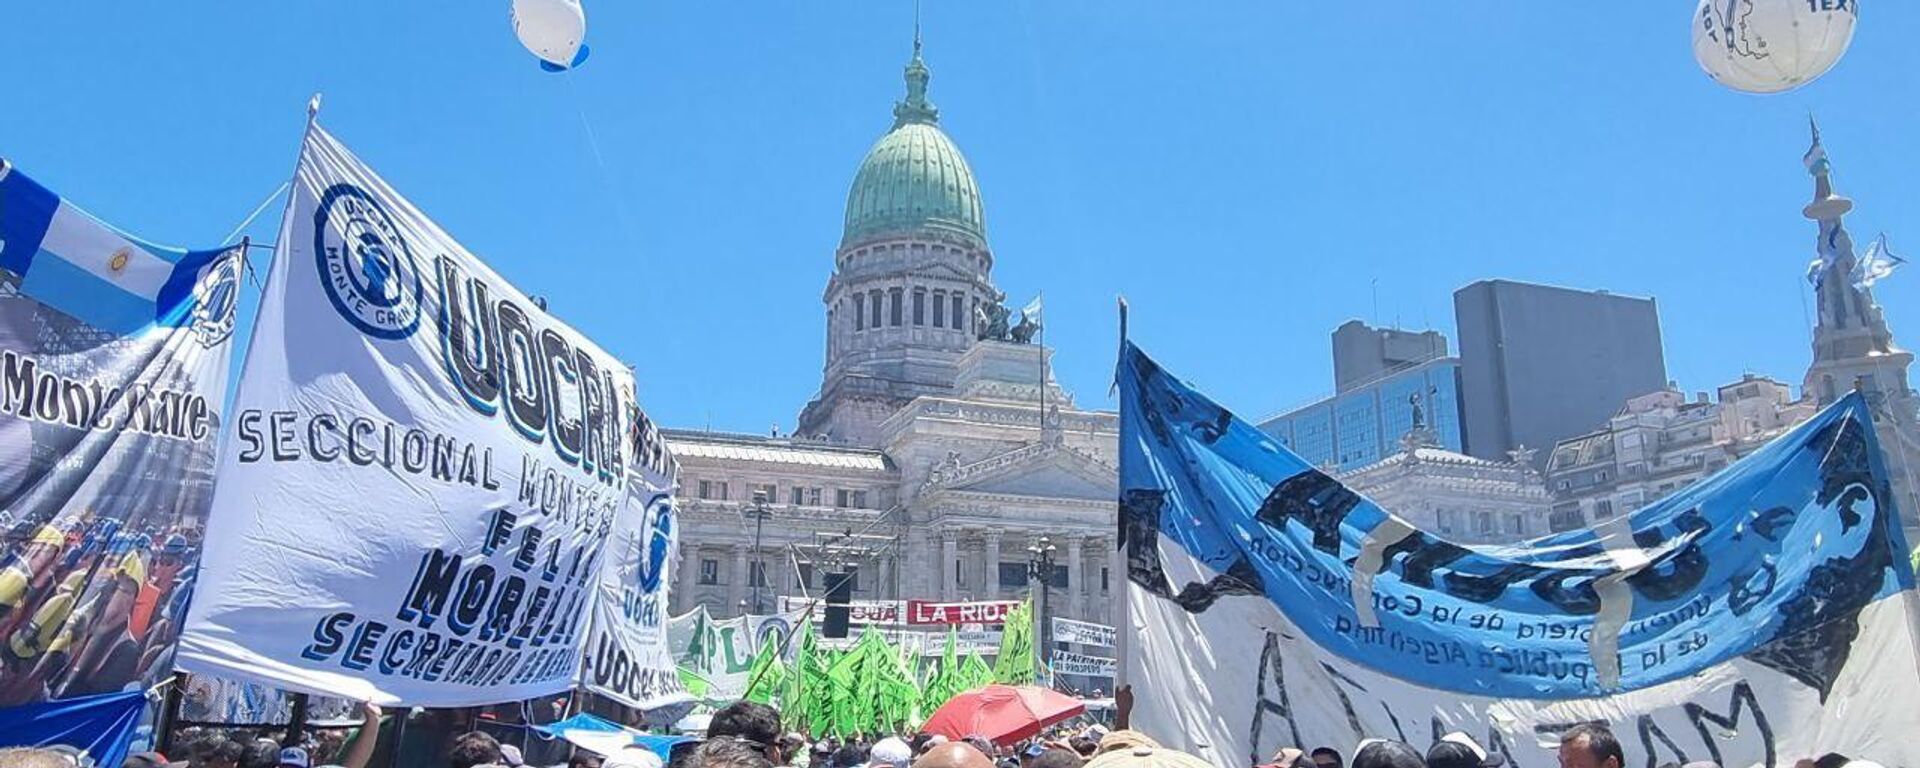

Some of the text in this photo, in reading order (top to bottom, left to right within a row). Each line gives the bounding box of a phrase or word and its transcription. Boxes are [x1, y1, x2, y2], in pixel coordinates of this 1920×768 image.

[326, 246, 368, 316] MONTE
[433, 253, 624, 491] UOCRA
[238, 408, 501, 491] SECCIONAL
[300, 612, 521, 688] SECRETARIO
[916, 602, 1008, 623] LA RIO
